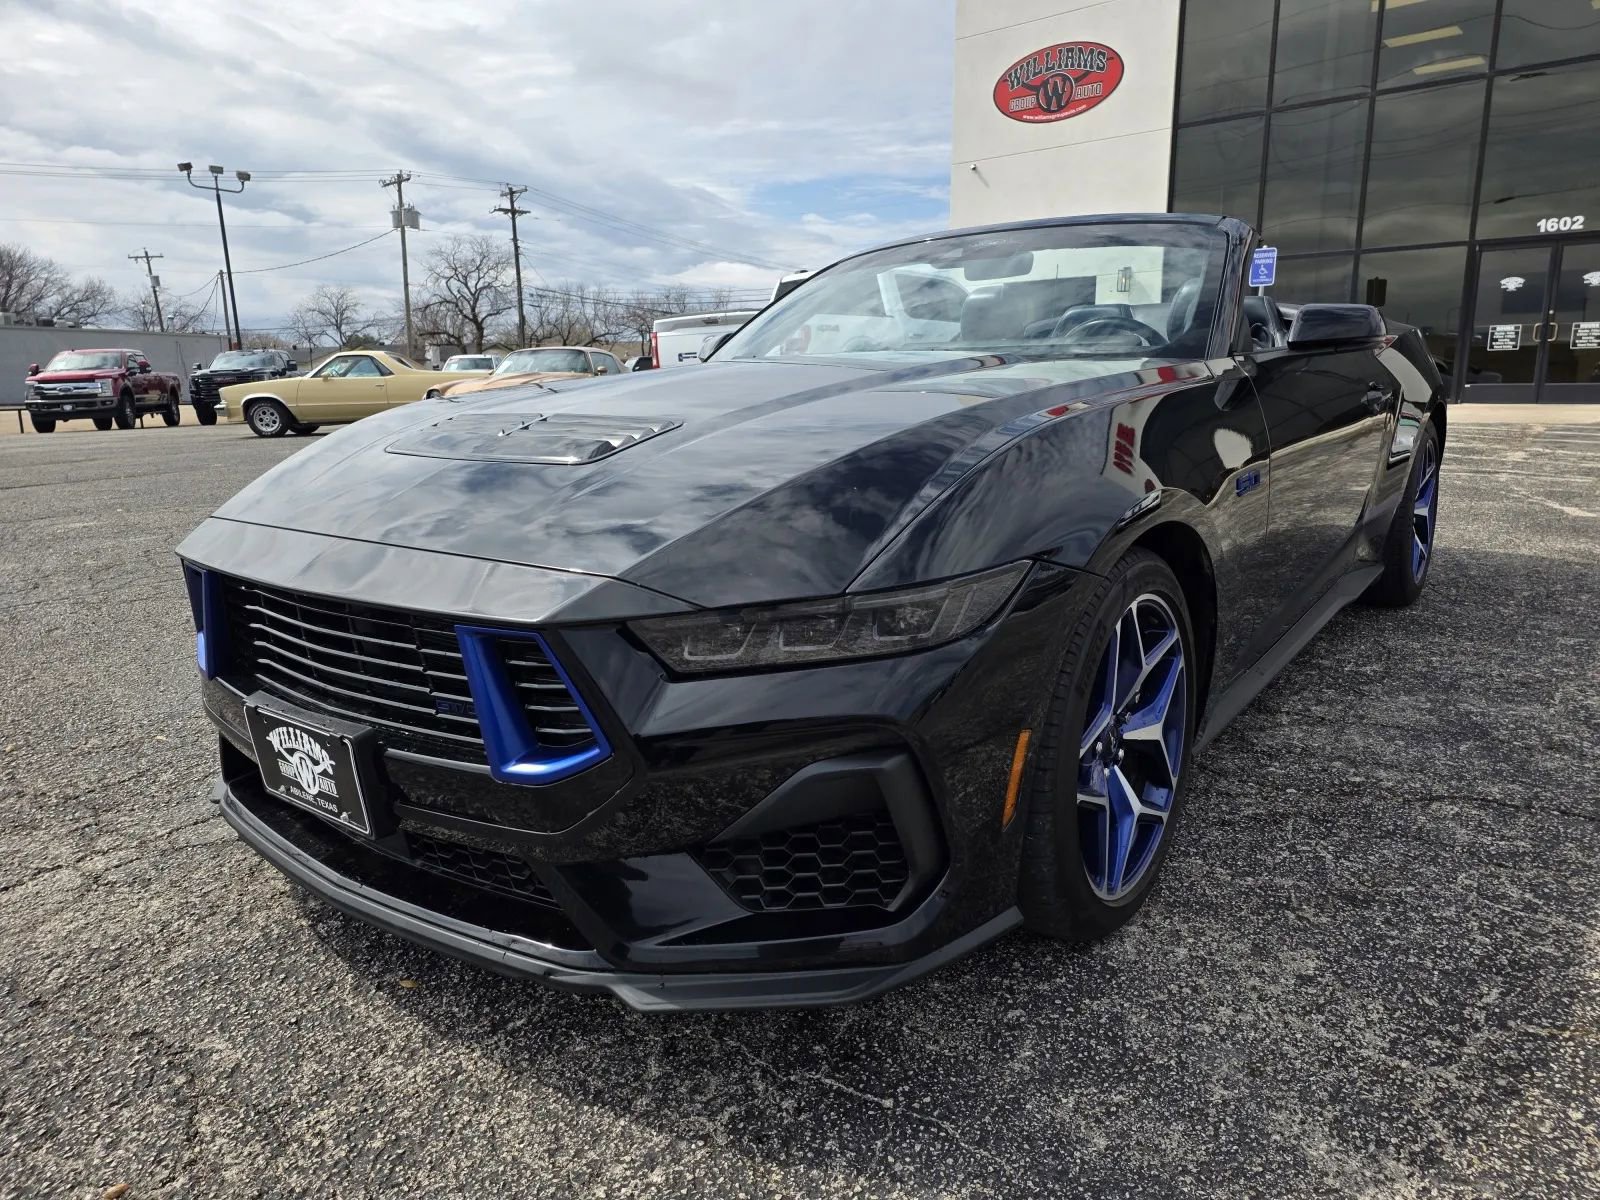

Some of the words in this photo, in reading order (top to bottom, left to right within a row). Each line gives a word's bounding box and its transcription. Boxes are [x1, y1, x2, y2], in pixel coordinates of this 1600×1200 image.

[1007, 46, 1107, 91] WILLIAMS
[1009, 95, 1036, 112] GROUP
[1075, 83, 1102, 100] AUTO
[1536, 215, 1585, 233] 1602
[268, 726, 334, 775] WILLIAMS
[290, 785, 317, 805] ABILENE,
[316, 797, 338, 813] TEXAS
[319, 777, 338, 795] AUTO
